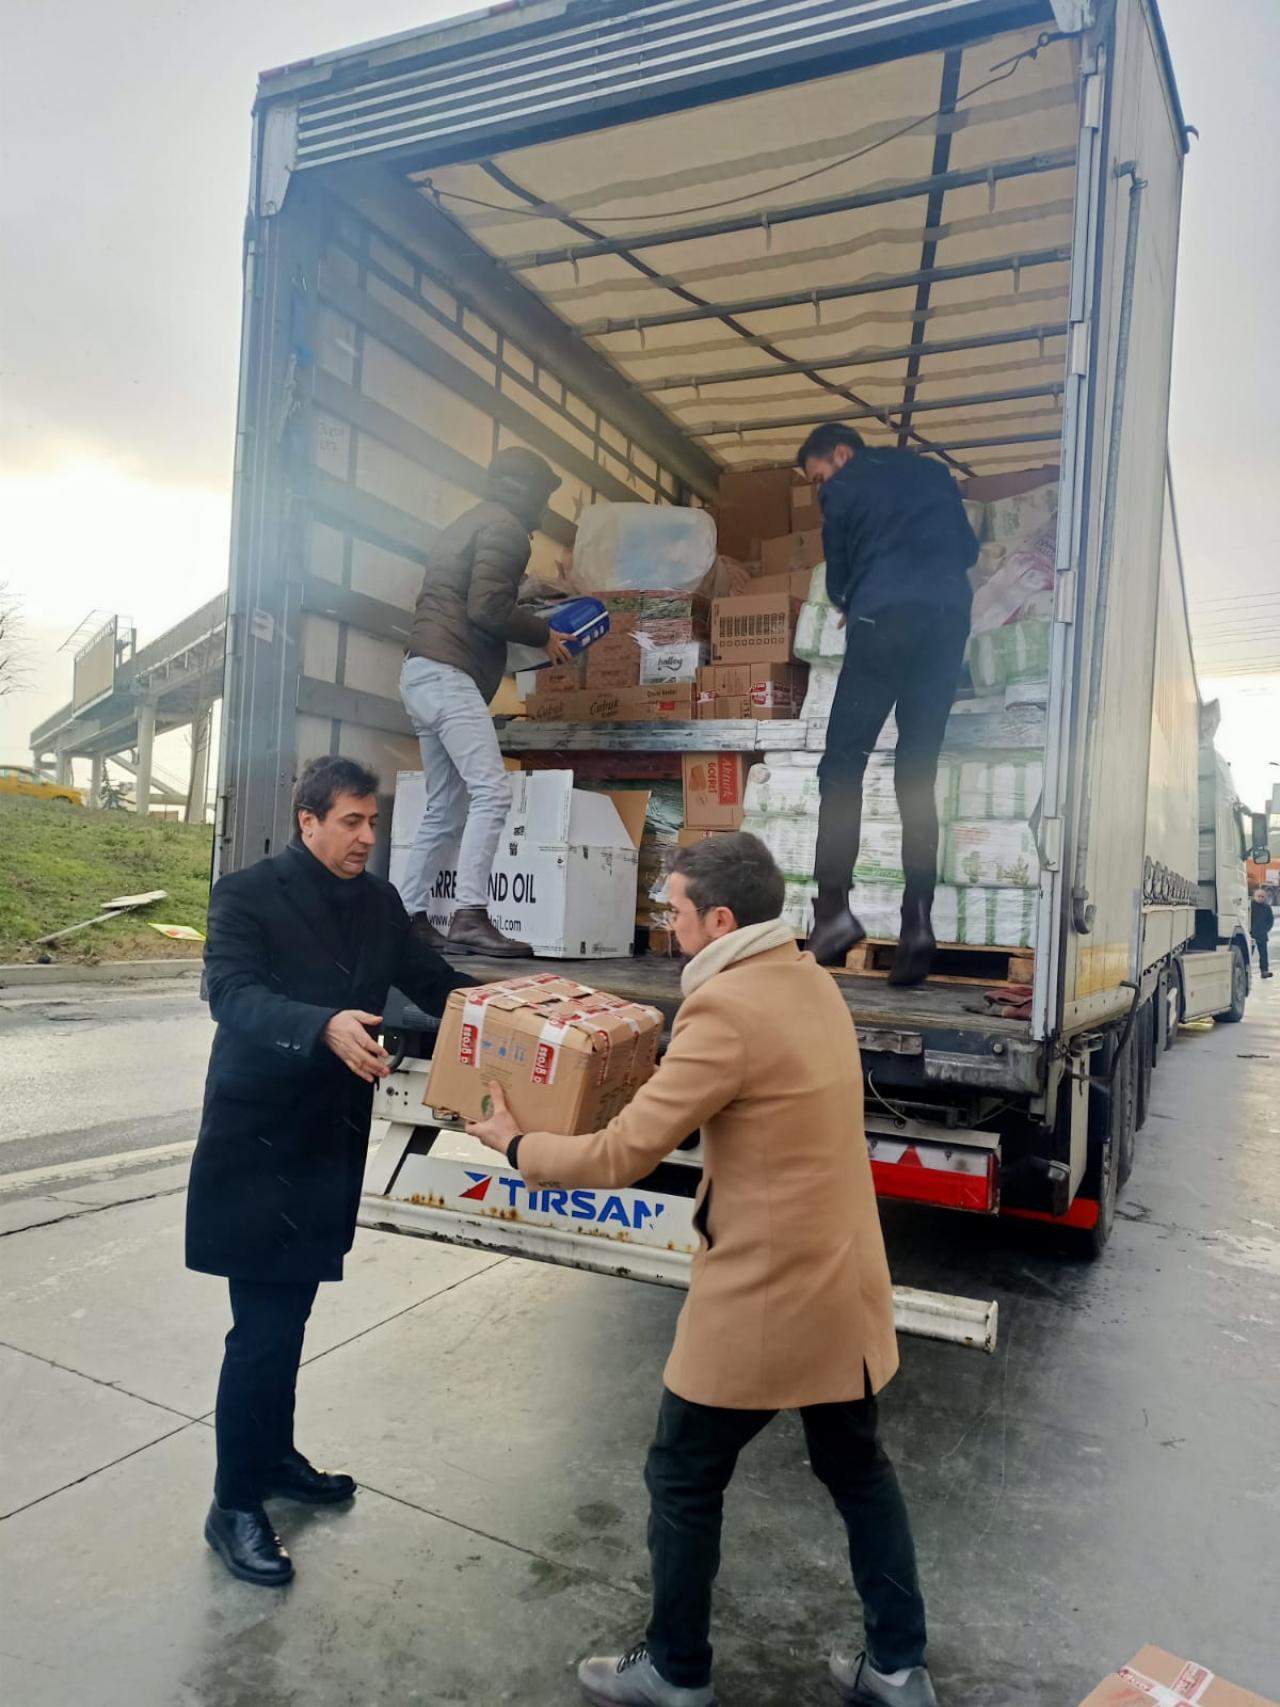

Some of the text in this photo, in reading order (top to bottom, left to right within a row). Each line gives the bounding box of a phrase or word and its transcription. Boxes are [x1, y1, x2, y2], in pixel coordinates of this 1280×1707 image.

[512, 872, 536, 903] OIL
[462, 1026, 473, 1055] gross
[535, 1045, 549, 1075] gross
[498, 1177, 665, 1230] TIRSAN
